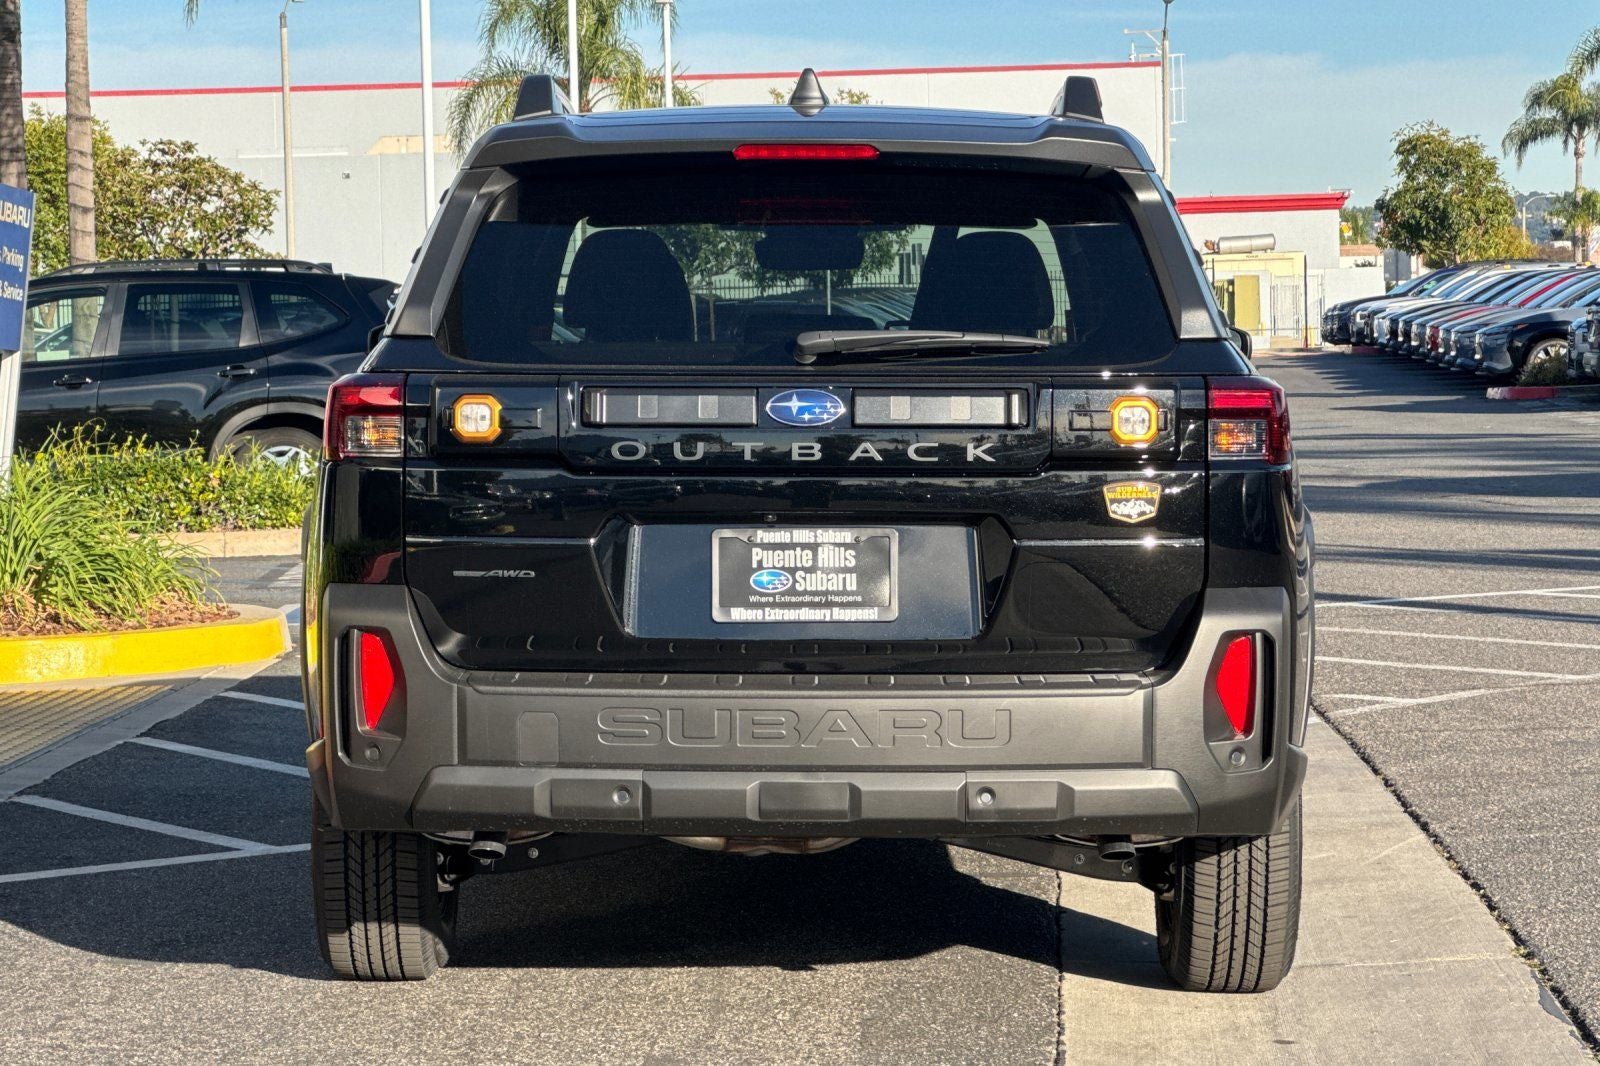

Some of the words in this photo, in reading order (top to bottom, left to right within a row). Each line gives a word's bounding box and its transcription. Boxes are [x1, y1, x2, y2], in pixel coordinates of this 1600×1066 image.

[0, 199, 31, 229] UBARU
[2, 245, 24, 272] Parking
[4, 281, 23, 301] Service
[610, 440, 996, 462] OUTBACK
[756, 530, 791, 543] Puente
[793, 529, 815, 543] Hills
[816, 529, 851, 543] Subaru
[751, 547, 813, 568] Puente
[817, 546, 856, 568] Hills
[483, 569, 536, 578] AWD
[795, 570, 857, 591] Subaru
[749, 595, 774, 603] Where
[775, 594, 826, 604] Extraordinary
[828, 594, 862, 604] Happens
[730, 607, 763, 620] Where
[764, 607, 831, 622] Extraordinary
[832, 607, 878, 621] Happens!
[597, 706, 1012, 748] SUBARU
